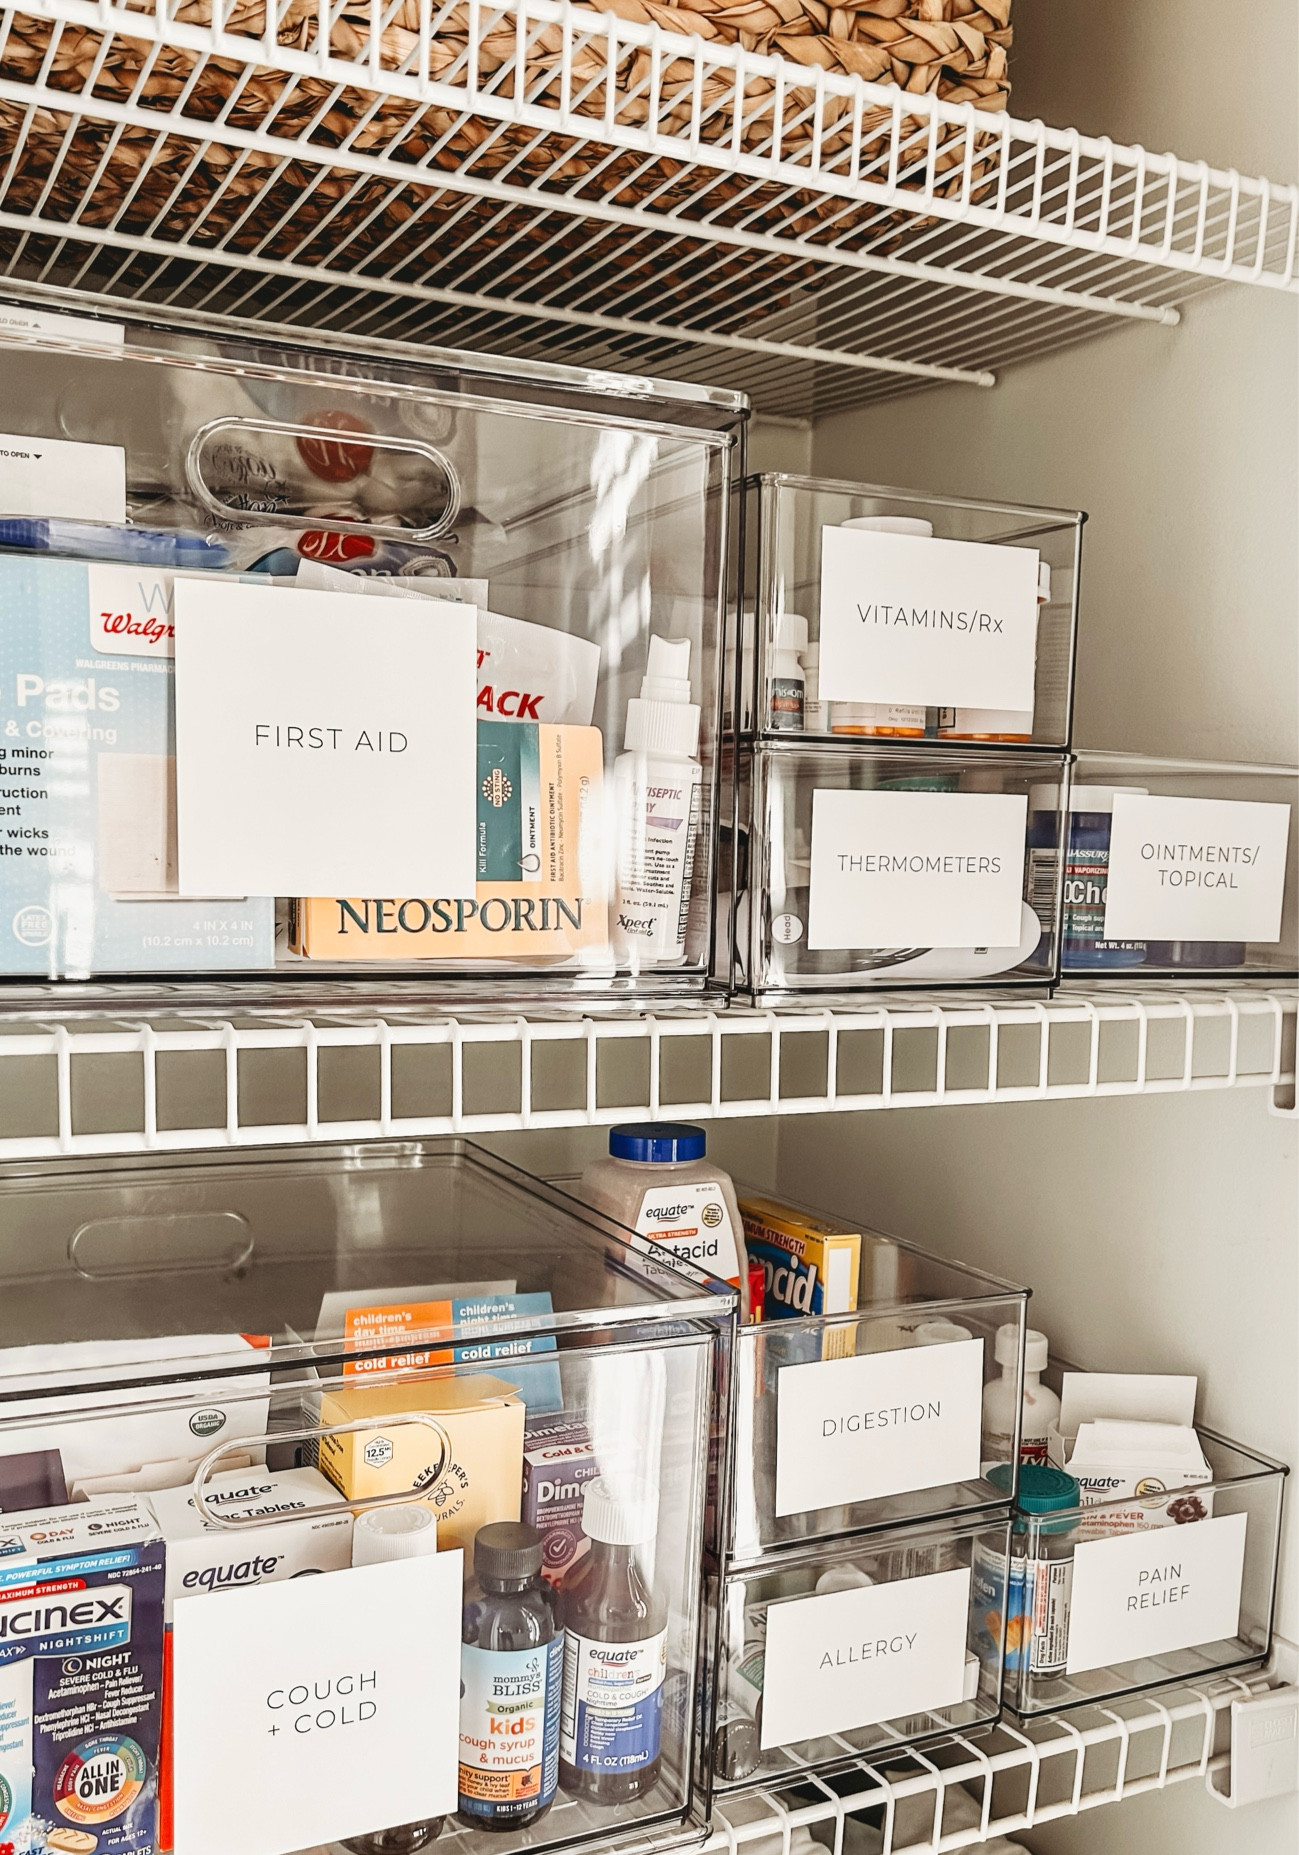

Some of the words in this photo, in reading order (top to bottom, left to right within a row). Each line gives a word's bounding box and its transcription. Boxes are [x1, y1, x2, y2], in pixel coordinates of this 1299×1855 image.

[10, 451, 30, 459] OPEN
[857, 603, 1004, 634] VITAMINS/Rx
[16, 673, 121, 712] Pads
[4, 719, 21, 737] &
[25, 720, 118, 745] Covering
[255, 724, 344, 750] FIRST
[355, 730, 409, 753] AID
[11, 746, 55, 759] minor
[0, 763, 41, 776] burns
[494, 794, 501, 806] NO
[6, 826, 49, 839] wicks
[479, 822, 487, 857] Formula
[0, 843, 23, 856] the
[1141, 843, 1261, 867] OINTMENTS/
[479, 858, 487, 873] Kill
[837, 854, 1002, 874] THERMOMETERS
[1158, 870, 1239, 890] TOPICAL
[336, 897, 585, 935] NEOSPORIN
[616, 914, 655, 931] Xpect
[1072, 914, 1092, 922] Cough
[193, 920, 201, 931] 4
[203, 920, 217, 931] IN
[230, 921, 239, 931] 4
[241, 920, 254, 931] IN
[783, 914, 792, 942] Head
[1072, 924, 1094, 932] Topical
[142, 935, 171, 948] (10.2
[174, 937, 193, 946] cm
[207, 935, 231, 946] 10.2
[232, 935, 255, 948] cm)
[1095, 941, 1107, 949] Net
[1108, 941, 1120, 950] Wt.
[1120, 942, 1125, 950] 4
[648, 1232, 666, 1240] ULTRA
[667, 1230, 697, 1238] STRENGTH
[766, 1228, 806, 1255] STRENGTH
[460, 1302, 515, 1317] children's
[353, 1311, 412, 1326] children's
[378, 1324, 406, 1335] time
[461, 1345, 490, 1360] cold
[495, 1342, 532, 1356] relief
[354, 1356, 387, 1372] cold
[390, 1352, 431, 1368] relief
[196, 1420, 220, 1430] ORGANIC
[198, 1414, 218, 1422] USDA
[822, 1400, 943, 1438] DIGESTION
[366, 1448, 385, 1458] 12.5
[542, 1448, 572, 1458] Cold
[242, 1500, 306, 1517] Tablets
[1109, 1512, 1144, 1520] FEVER
[106, 1518, 140, 1528] NIGHT
[48, 1528, 75, 1538] DAY
[6, 1567, 53, 1581] POWERFUL
[55, 1561, 98, 1574] SYMPTOM
[98, 1554, 130, 1567] RELIEF!
[182, 1554, 279, 1590] equate
[1138, 1563, 1183, 1586] PAIN
[0, 1588, 34, 1600] AXIMUM
[36, 1582, 79, 1594] STRENGTH
[1126, 1584, 1192, 1612] RELIEF
[39, 1629, 125, 1650] NIGHTSHIFT
[818, 1632, 918, 1670] ALLERGY
[86, 1652, 132, 1670] NIGHT
[60, 1674, 91, 1686] SEVERE
[92, 1670, 114, 1680] COLD
[114, 1668, 122, 1677] &
[123, 1665, 139, 1676] FLU
[48, 1682, 100, 1700] Acetaminophen
[105, 1679, 118, 1688] Pain
[104, 1689, 120, 1698] Fever
[121, 1685, 144, 1696] Reducer
[266, 1670, 377, 1710] COUGH
[492, 1680, 541, 1696] BLISS
[587, 1690, 610, 1700] COLD
[619, 1690, 647, 1700] COUGH
[34, 1704, 86, 1724] Dextromethorphan
[86, 1702, 98, 1712] HBr
[102, 1698, 120, 1709] Cough
[121, 1691, 156, 1706] Suppressant
[497, 1701, 534, 1714] Organic
[586, 1698, 618, 1706] Nighttime
[40, 1716, 80, 1734] Phenylephrine
[96, 1710, 112, 1720] Nasal
[112, 1702, 150, 1718] Decongestant
[267, 1724, 280, 1737] +
[294, 1700, 378, 1734] COLD
[52, 1726, 84, 1742] Triprolidine
[100, 1716, 138, 1730] Antihistamine
[490, 1717, 536, 1736] kids
[85, 1738, 98, 1749] SORE
[99, 1736, 118, 1744] THROAT
[94, 1746, 110, 1754] FEVER
[459, 1733, 496, 1750] cough
[499, 1738, 536, 1752] syrup
[479, 1754, 489, 1764] &
[492, 1753, 535, 1766] mucus
[582, 1754, 589, 1762] 4
[590, 1755, 602, 1765] FL
[604, 1756, 618, 1766] OZ
[81, 1764, 104, 1781] ALL
[106, 1760, 120, 1776] IN
[80, 1774, 120, 1798] ONE
[522, 1798, 538, 1810] YEARS
[102, 1826, 122, 1836] ACTUAL
[108, 1838, 120, 1846] FOR
[120, 1834, 136, 1842] AGES
[137, 1830, 147, 1838] 12+
